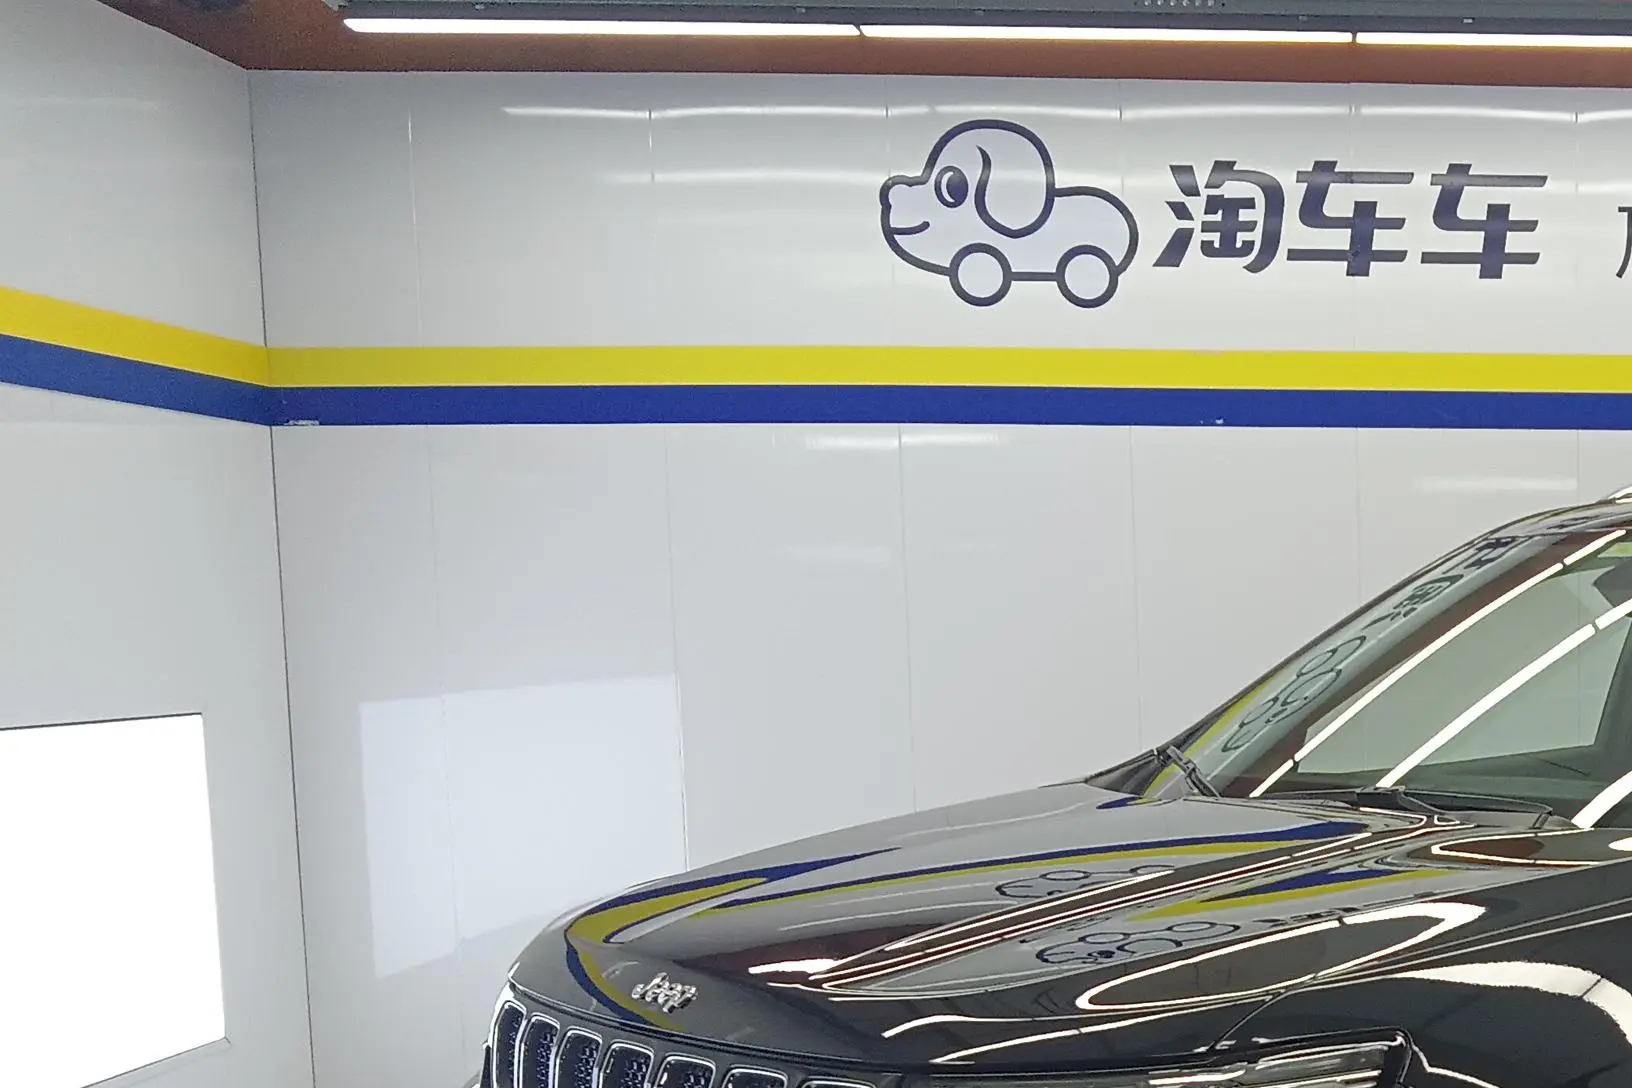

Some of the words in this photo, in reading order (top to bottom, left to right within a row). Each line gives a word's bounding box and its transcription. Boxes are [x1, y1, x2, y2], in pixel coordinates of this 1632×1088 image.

[1152, 159, 1548, 280] 淘车车
[631, 971, 698, 1014] Jeep
